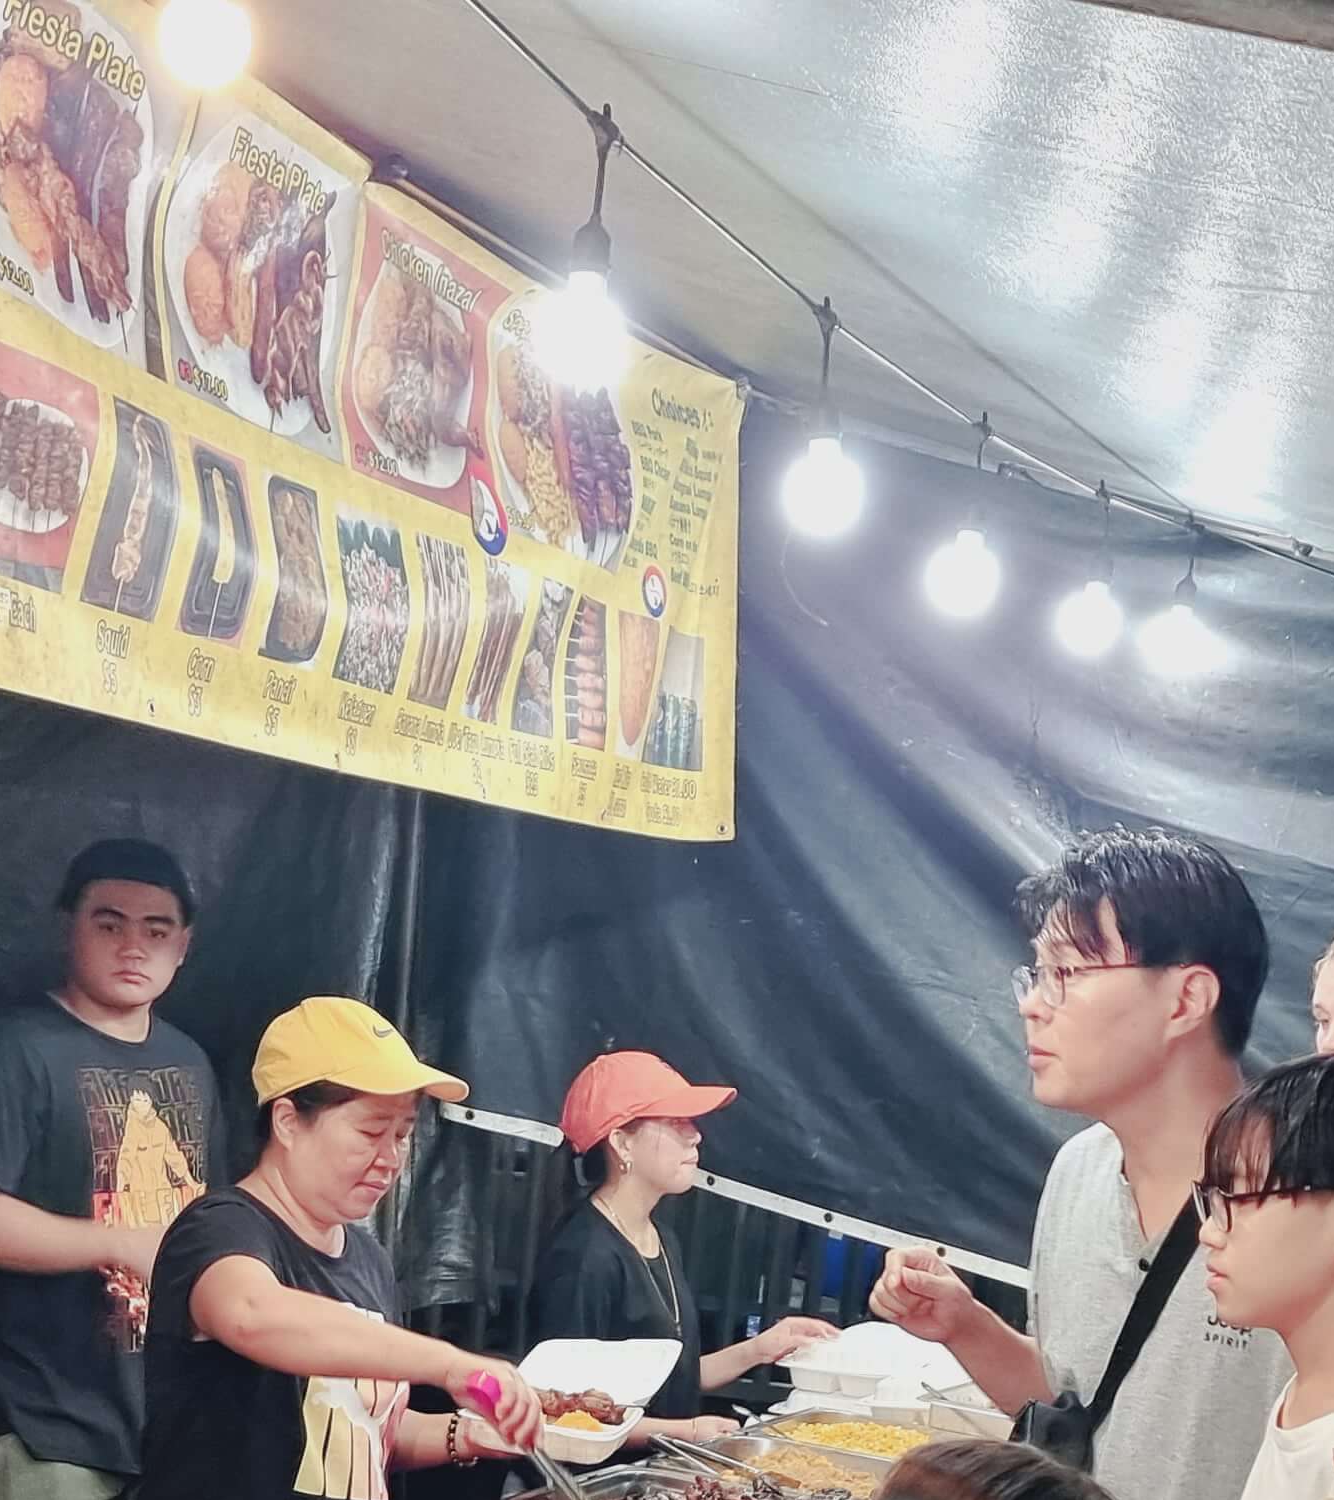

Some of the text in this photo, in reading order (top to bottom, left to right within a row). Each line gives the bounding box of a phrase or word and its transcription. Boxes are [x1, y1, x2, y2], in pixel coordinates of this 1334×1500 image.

[86, 33, 146, 101] Plate
[229, 126, 328, 216] Fiesta Plate
[96, 617, 132, 660] Squid
